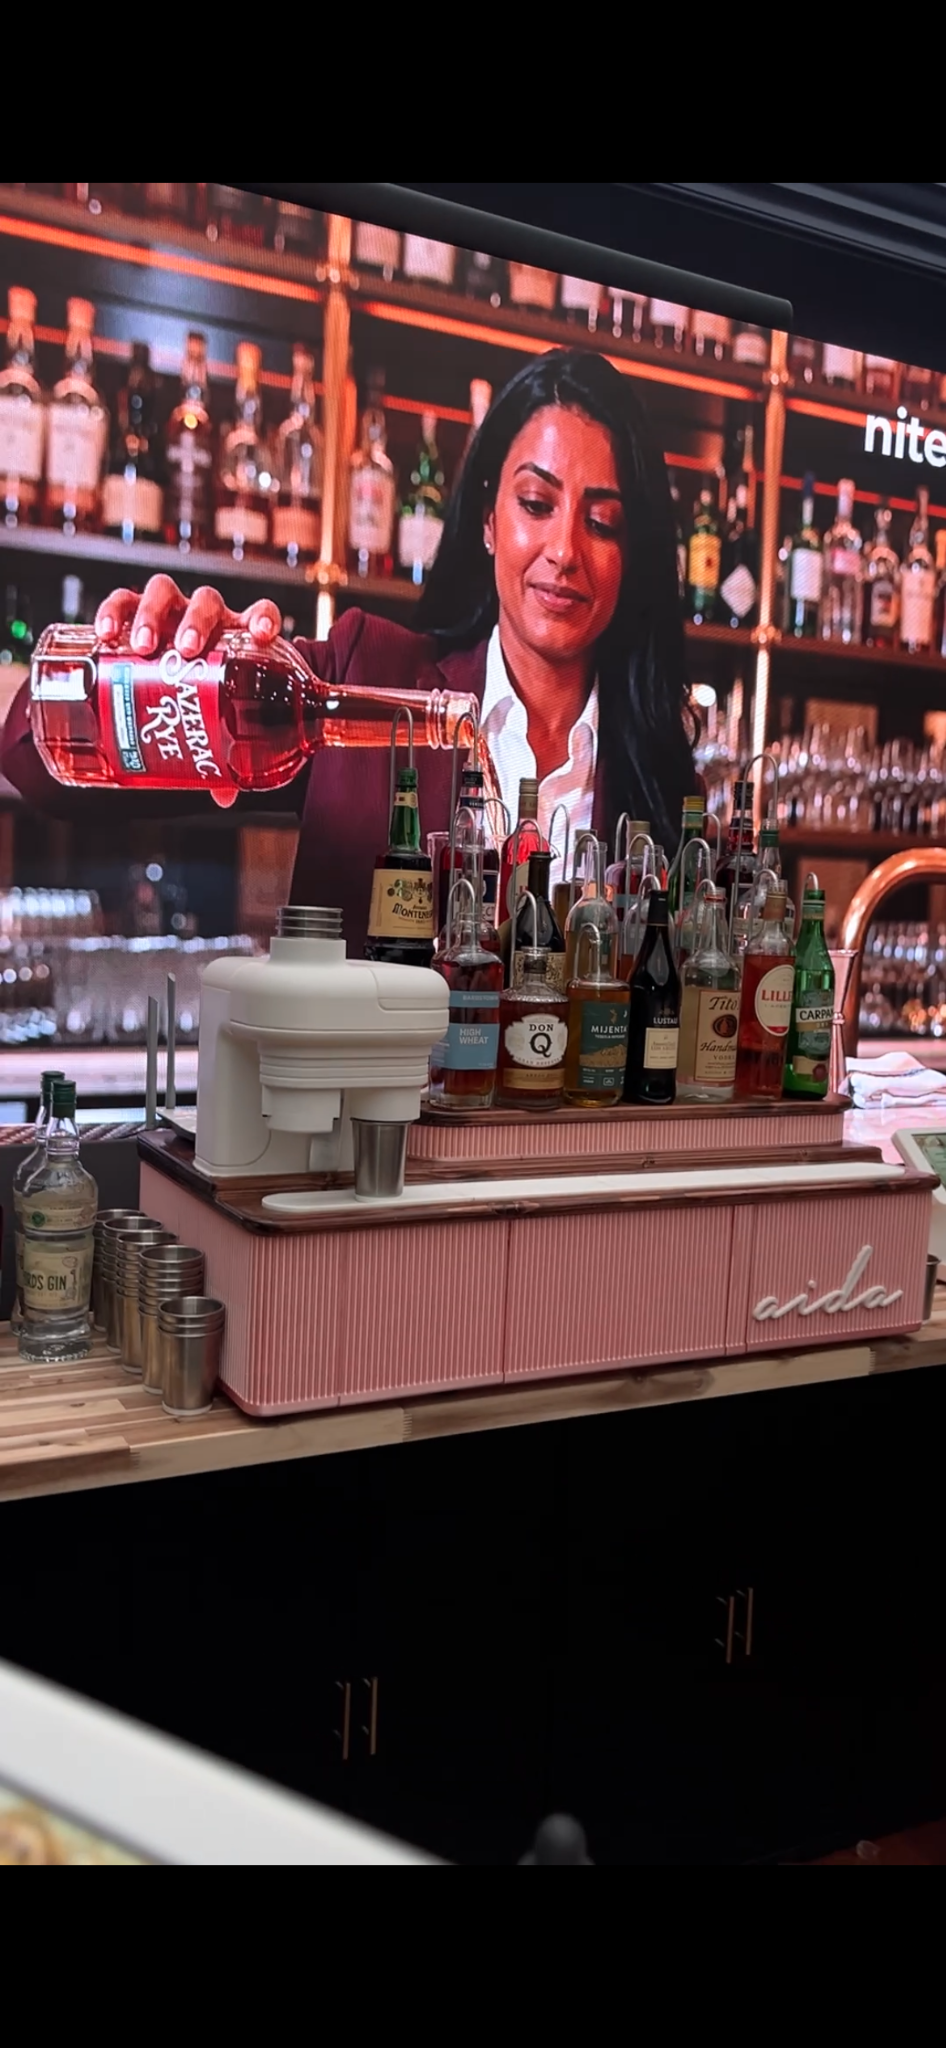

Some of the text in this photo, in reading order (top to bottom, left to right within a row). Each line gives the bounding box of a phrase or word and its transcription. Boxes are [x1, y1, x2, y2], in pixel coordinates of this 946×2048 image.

[864, 405, 946, 468] nite
[141, 695, 183, 760] RYE
[160, 649, 222, 777] SAZERAC
[459, 1036, 489, 1044] WHEAT
[529, 1032, 552, 1058] Q
[47, 1275, 67, 1290] GIN
[753, 1245, 903, 1321] aida
